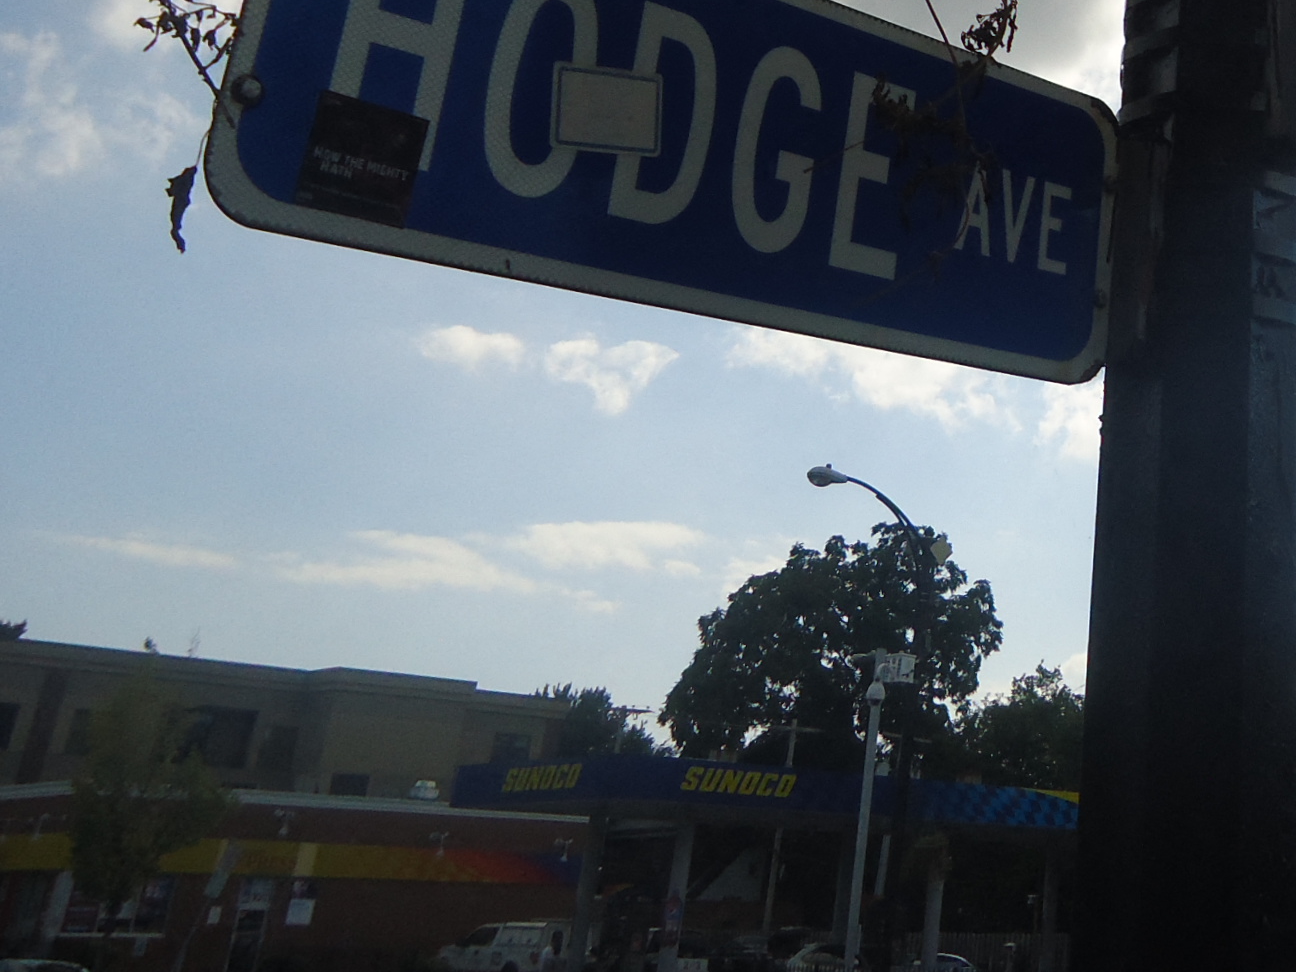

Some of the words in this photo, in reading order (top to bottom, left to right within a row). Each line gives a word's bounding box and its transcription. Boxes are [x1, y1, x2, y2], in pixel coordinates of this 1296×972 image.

[313, 145, 342, 164] HOW
[344, 155, 366, 170] THE
[366, 159, 410, 181] MIGHTY
[955, 167, 1073, 276] AVE
[501, 763, 583, 792] SUNOCO
[680, 766, 797, 798] SUNOCO
